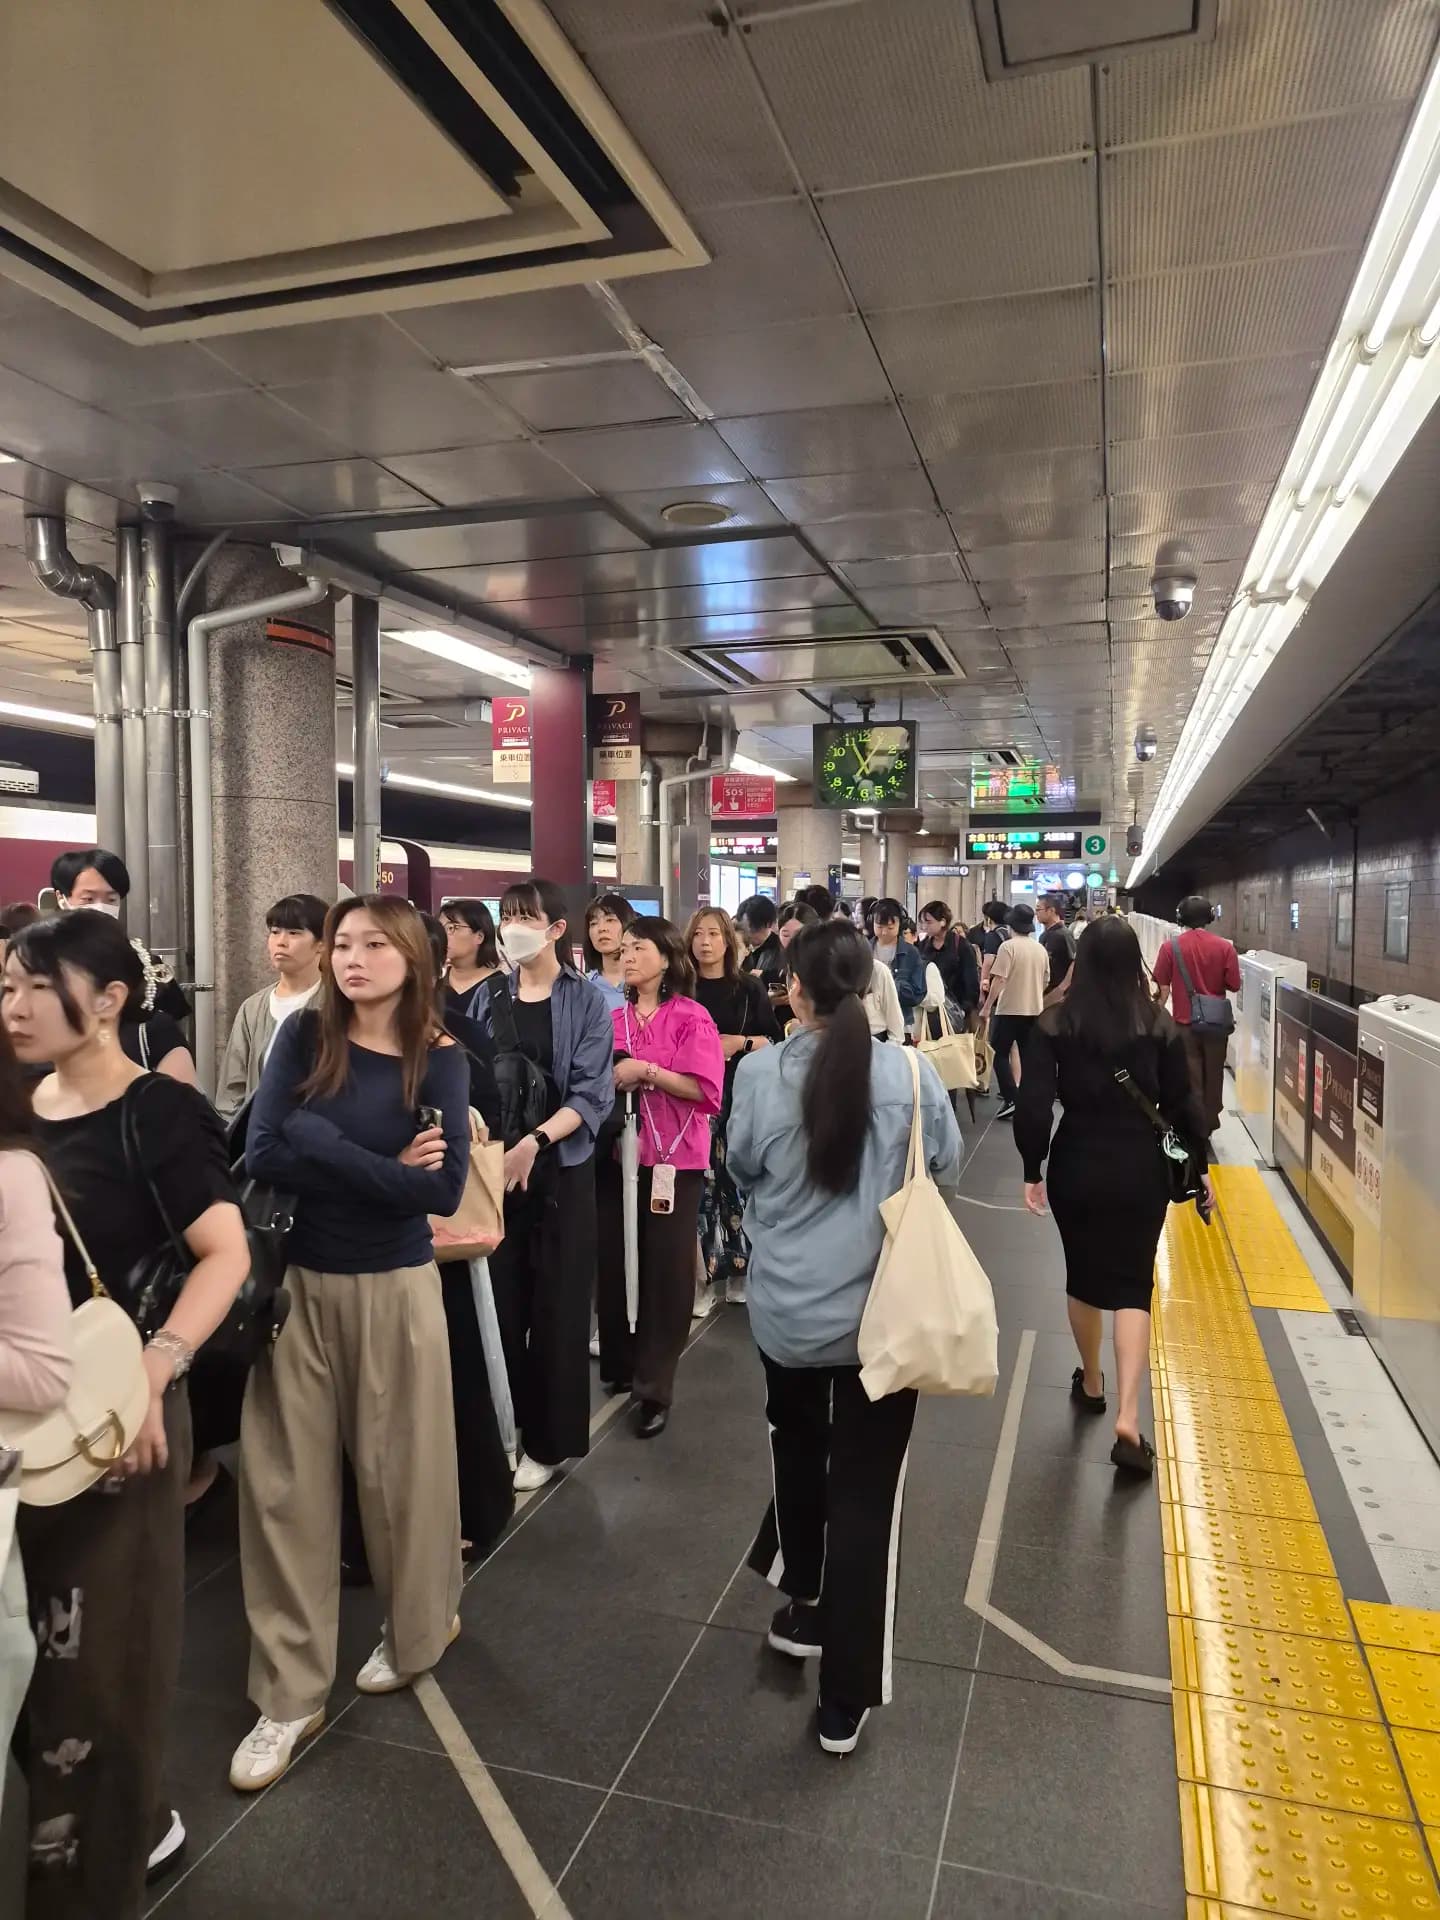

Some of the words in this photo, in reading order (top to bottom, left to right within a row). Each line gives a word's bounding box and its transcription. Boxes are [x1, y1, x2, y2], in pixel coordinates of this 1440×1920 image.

[858, 731, 871, 742] 12
[845, 737, 856, 747] 11
[833, 747, 846, 757] 10
[888, 745, 897, 754] 2
[826, 761, 836, 771] 9
[895, 760, 904, 769] 3
[833, 777, 842, 787] 8
[888, 776, 897, 785] 4
[725, 788, 744, 796] SOS
[846, 786, 855, 795] 7
[860, 788, 869, 798] 6
[874, 785, 883, 795] 5
[1091, 839, 1100, 852] 3
